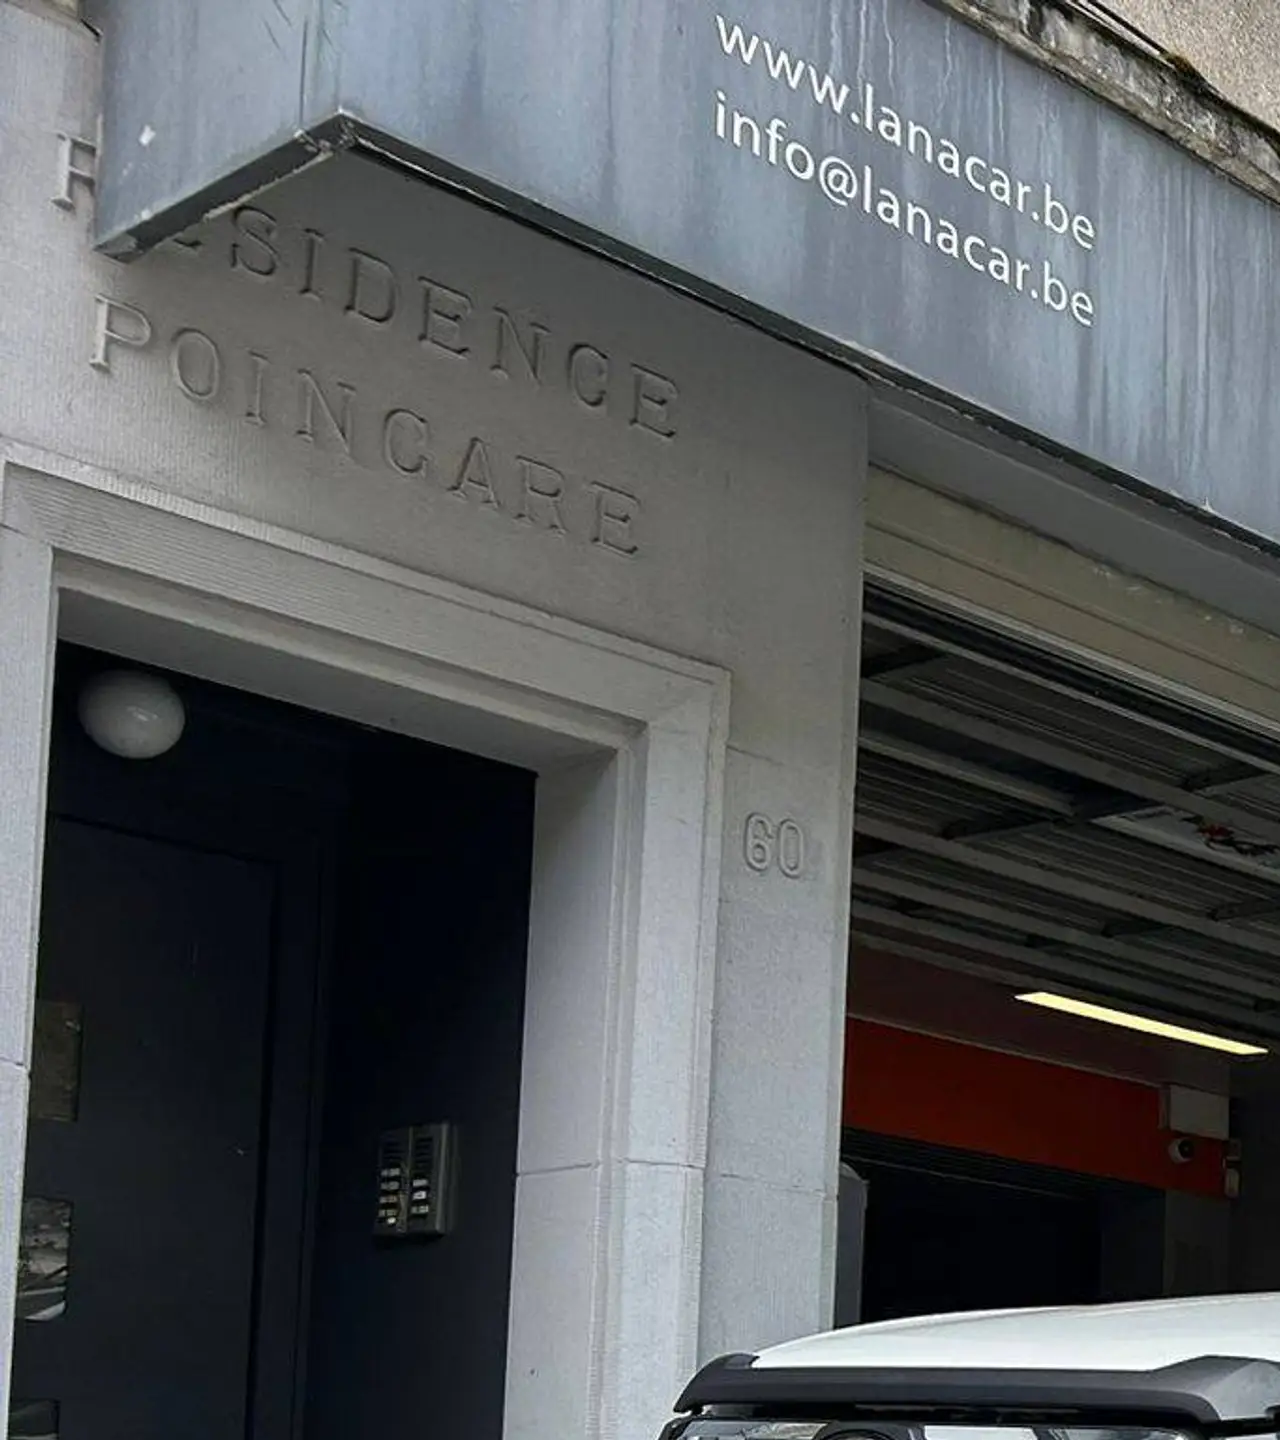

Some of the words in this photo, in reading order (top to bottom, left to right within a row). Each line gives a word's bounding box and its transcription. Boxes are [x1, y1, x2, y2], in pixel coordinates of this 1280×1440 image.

[714, 91, 1094, 326] info@lanacar.be
[715, 14, 1095, 248] www.lanacar.be
[51, 131, 681, 439] RSIDENCE
[743, 811, 804, 880] 60
